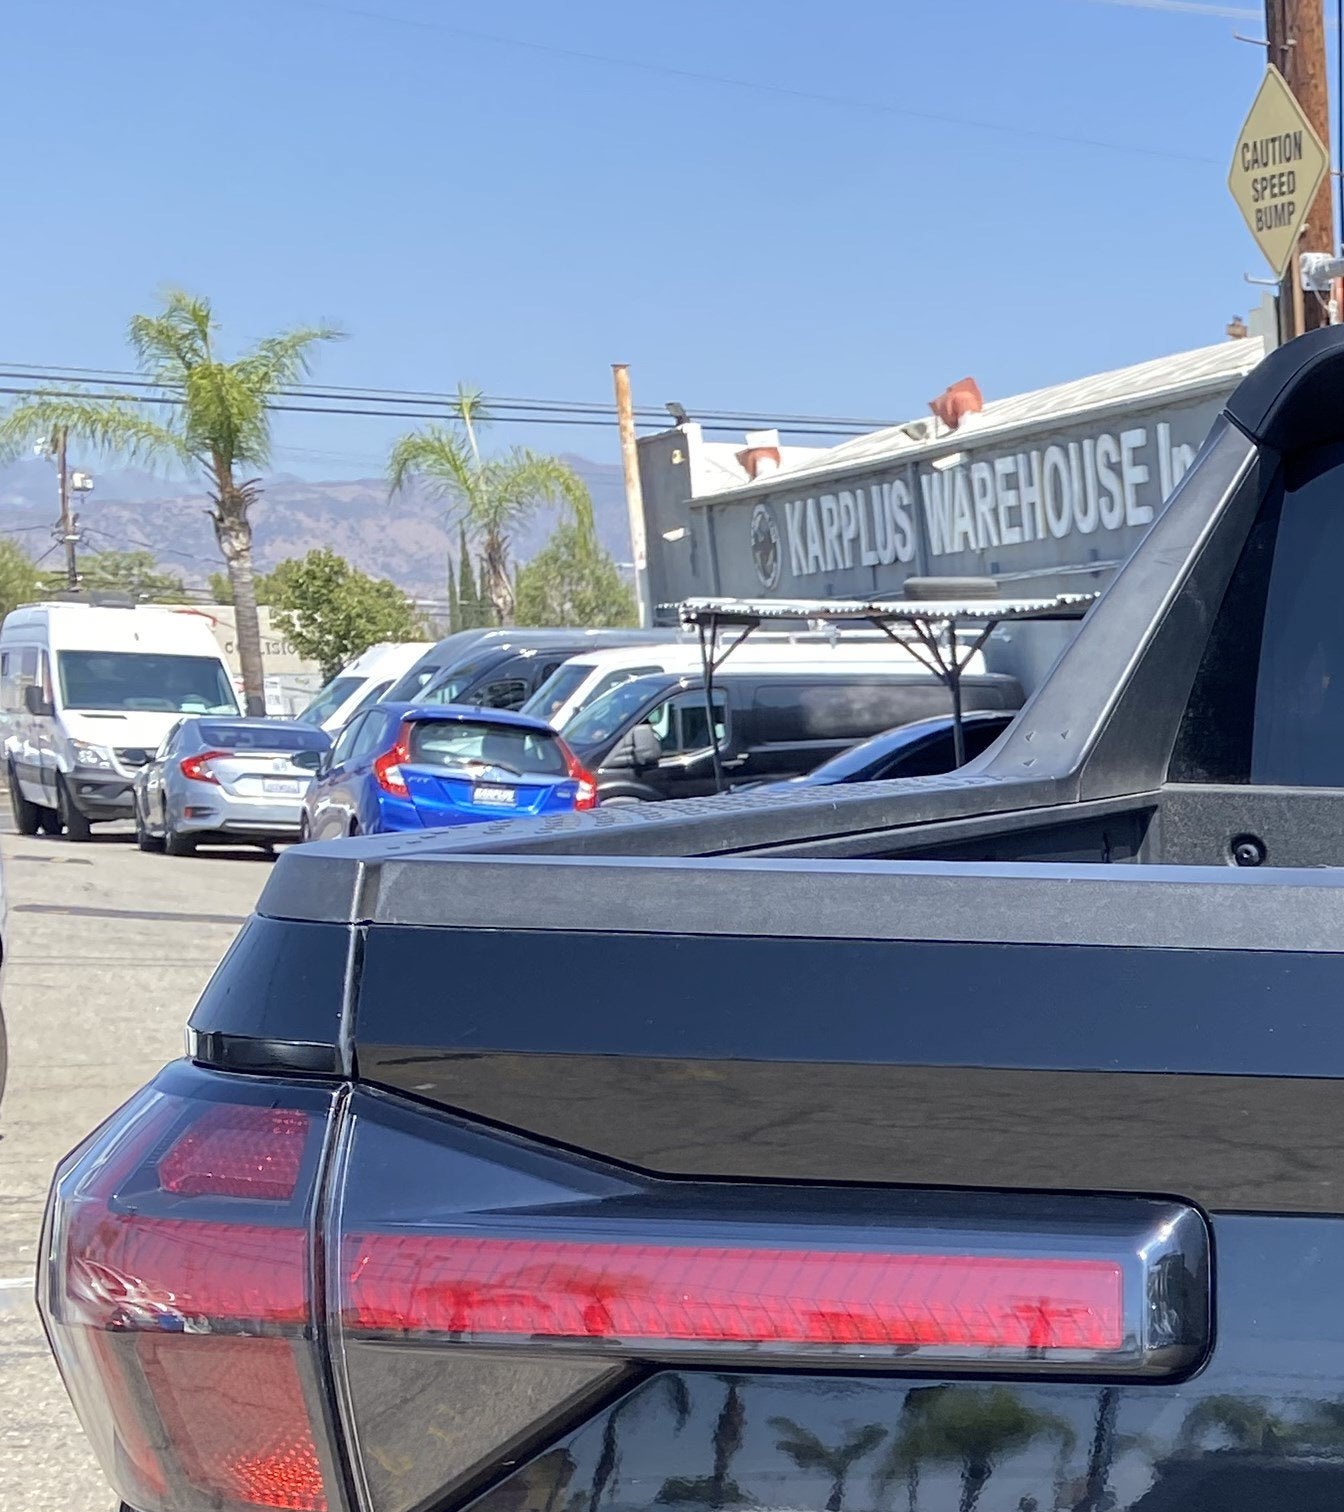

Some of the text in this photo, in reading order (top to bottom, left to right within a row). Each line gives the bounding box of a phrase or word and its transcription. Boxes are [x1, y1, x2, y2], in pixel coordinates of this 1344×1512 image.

[1241, 131, 1303, 172] CAUTION
[1252, 171, 1296, 203] SPEED
[1256, 202, 1296, 231] BUMP
[785, 422, 1204, 577] KARPLUS WAREHOUSE In
